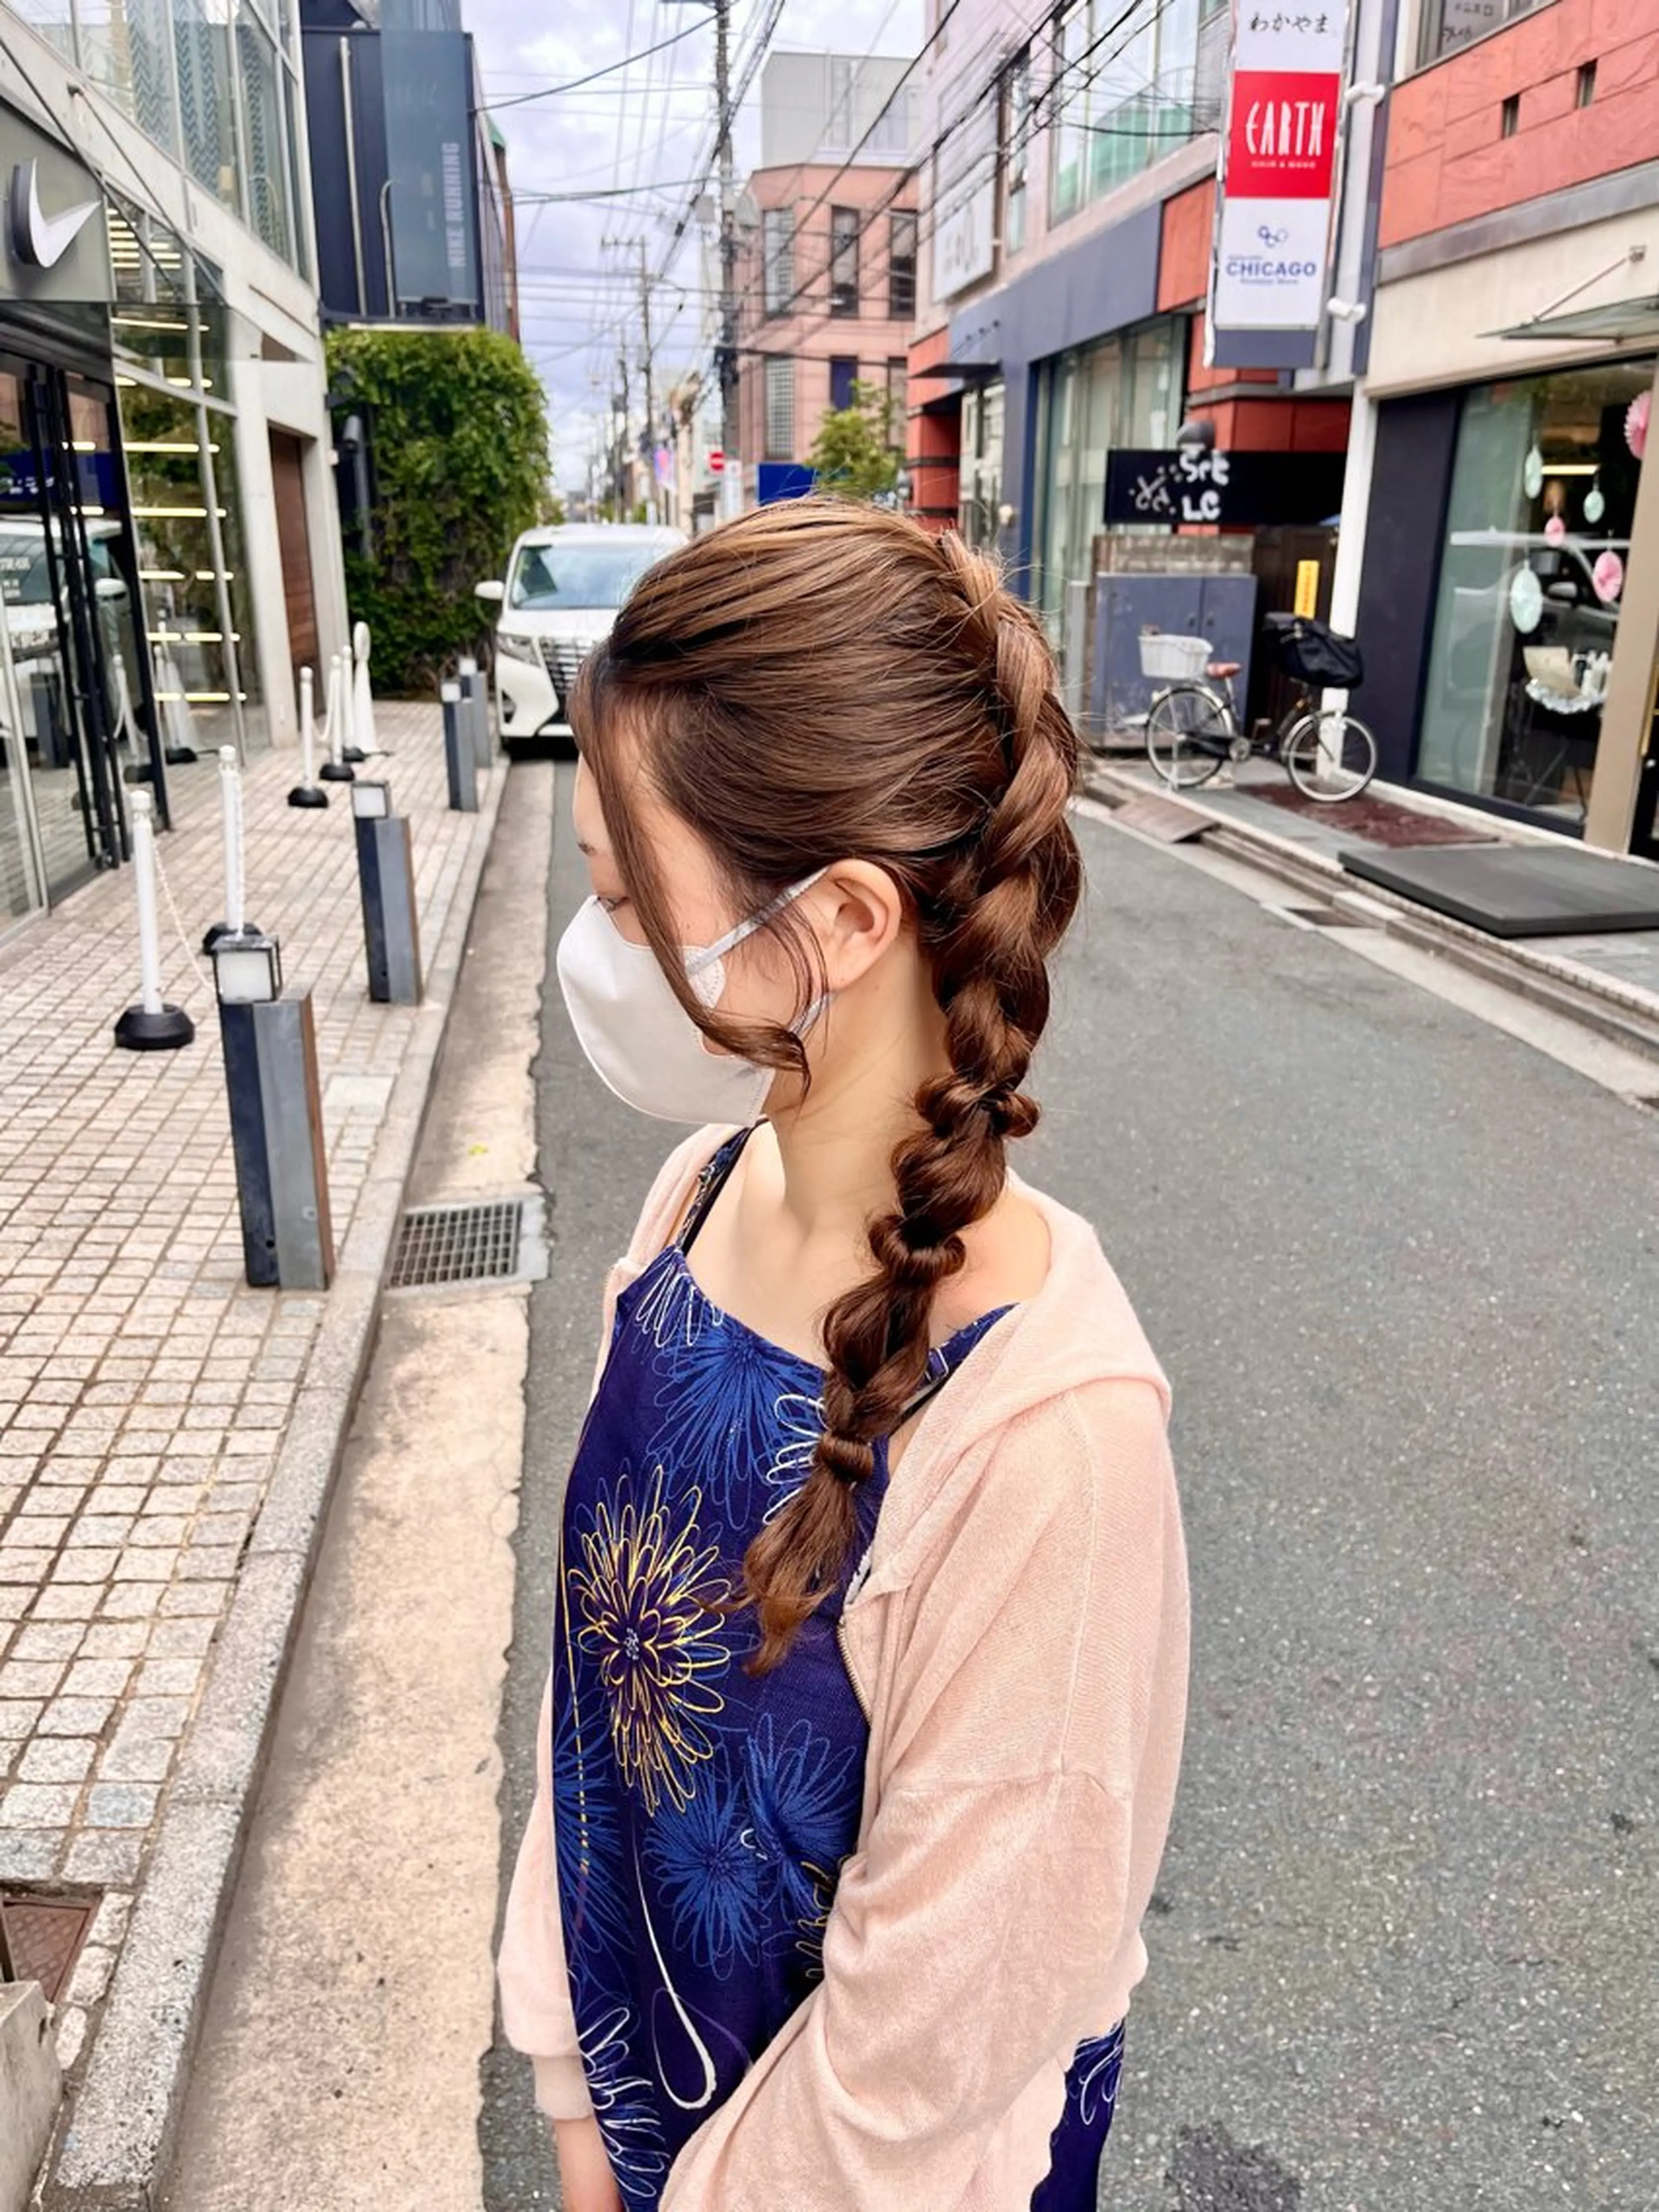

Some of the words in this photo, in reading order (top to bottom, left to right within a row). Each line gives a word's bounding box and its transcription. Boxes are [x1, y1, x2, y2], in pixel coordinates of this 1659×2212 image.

[1249, 12, 1328, 33] わかやま
[1245, 100, 1325, 156] EARTH
[1226, 261, 1316, 276] CHICAGO
